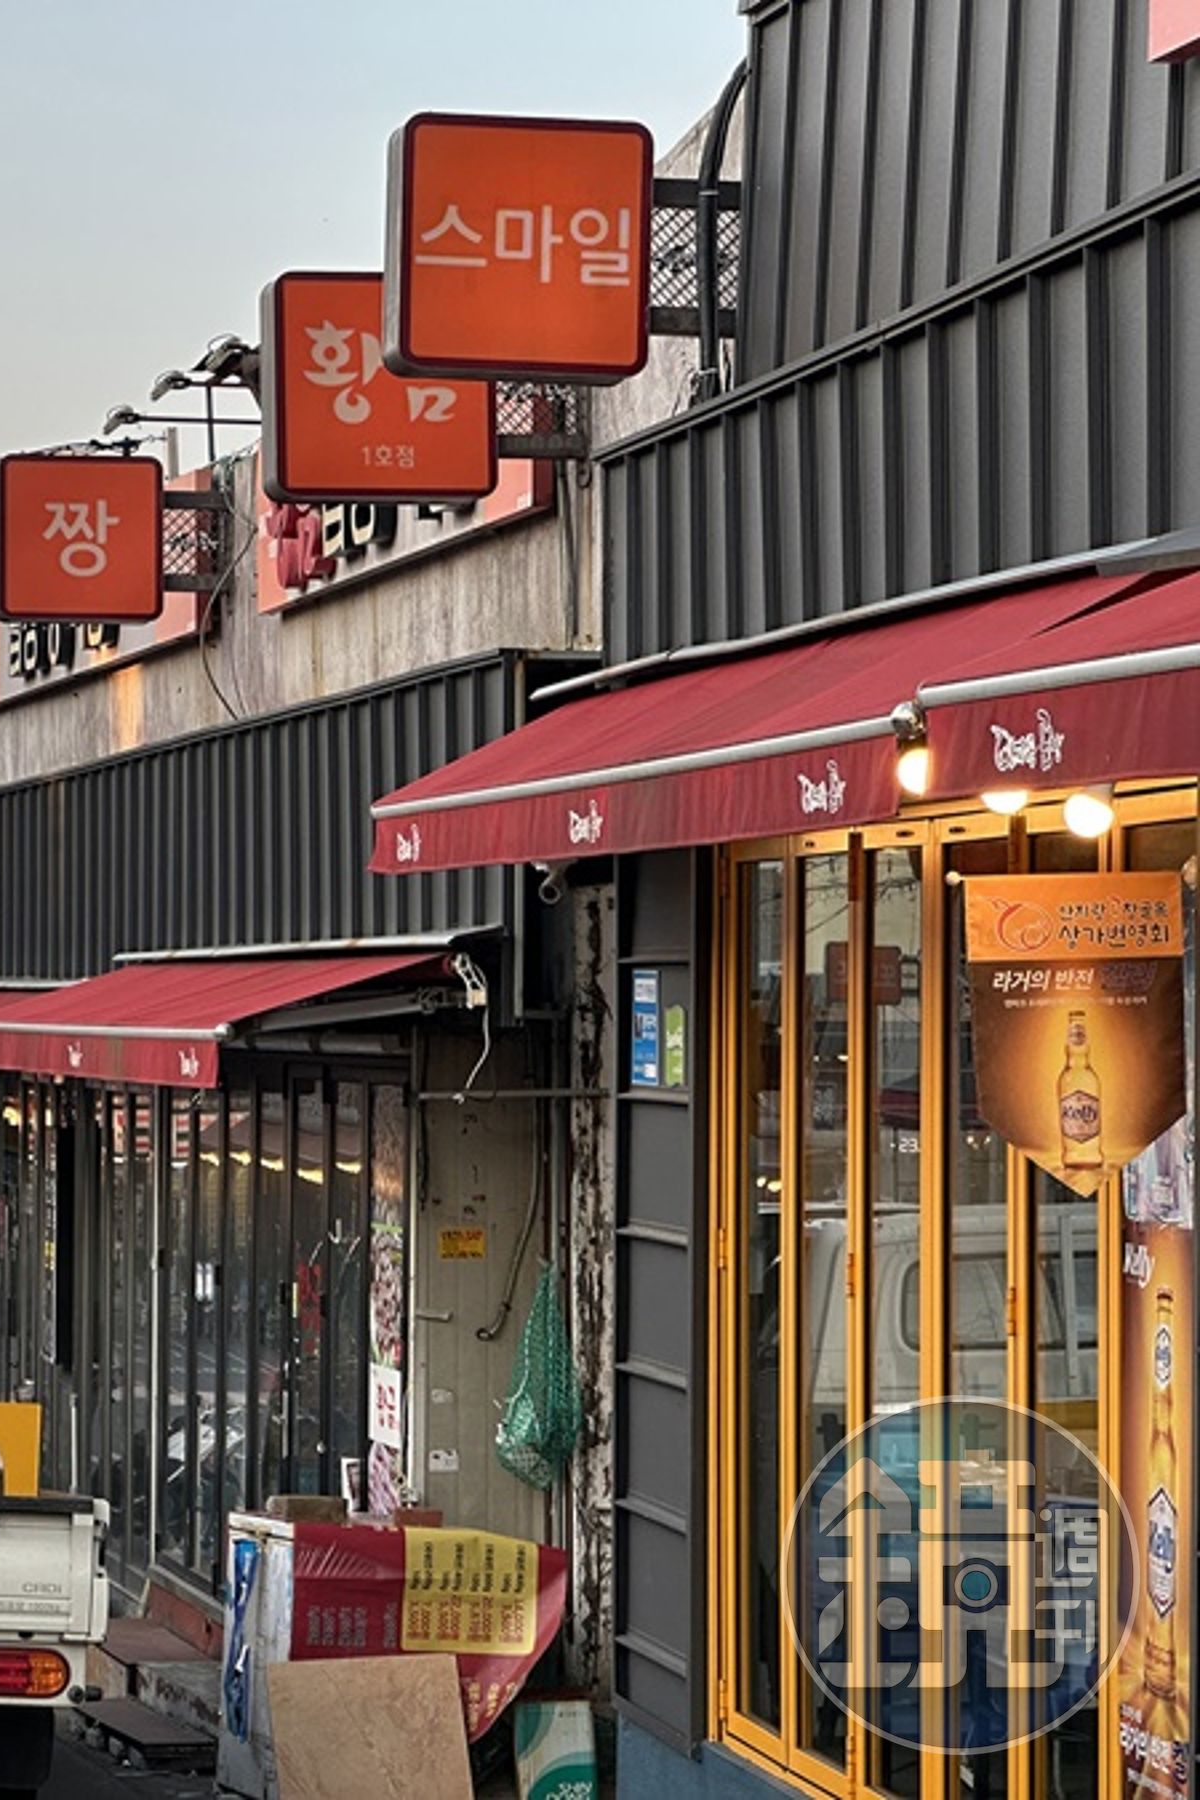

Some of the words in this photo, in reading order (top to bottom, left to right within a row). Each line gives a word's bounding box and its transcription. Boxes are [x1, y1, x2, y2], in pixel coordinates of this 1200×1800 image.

[415, 204, 632, 287] 스마일
[361, 445, 416, 469] 1호점
[43, 499, 120, 578] 짱
[1058, 923, 1170, 949] 상가번영회
[992, 969, 1051, 993] 라거의
[1055, 968, 1095, 991] 반전
